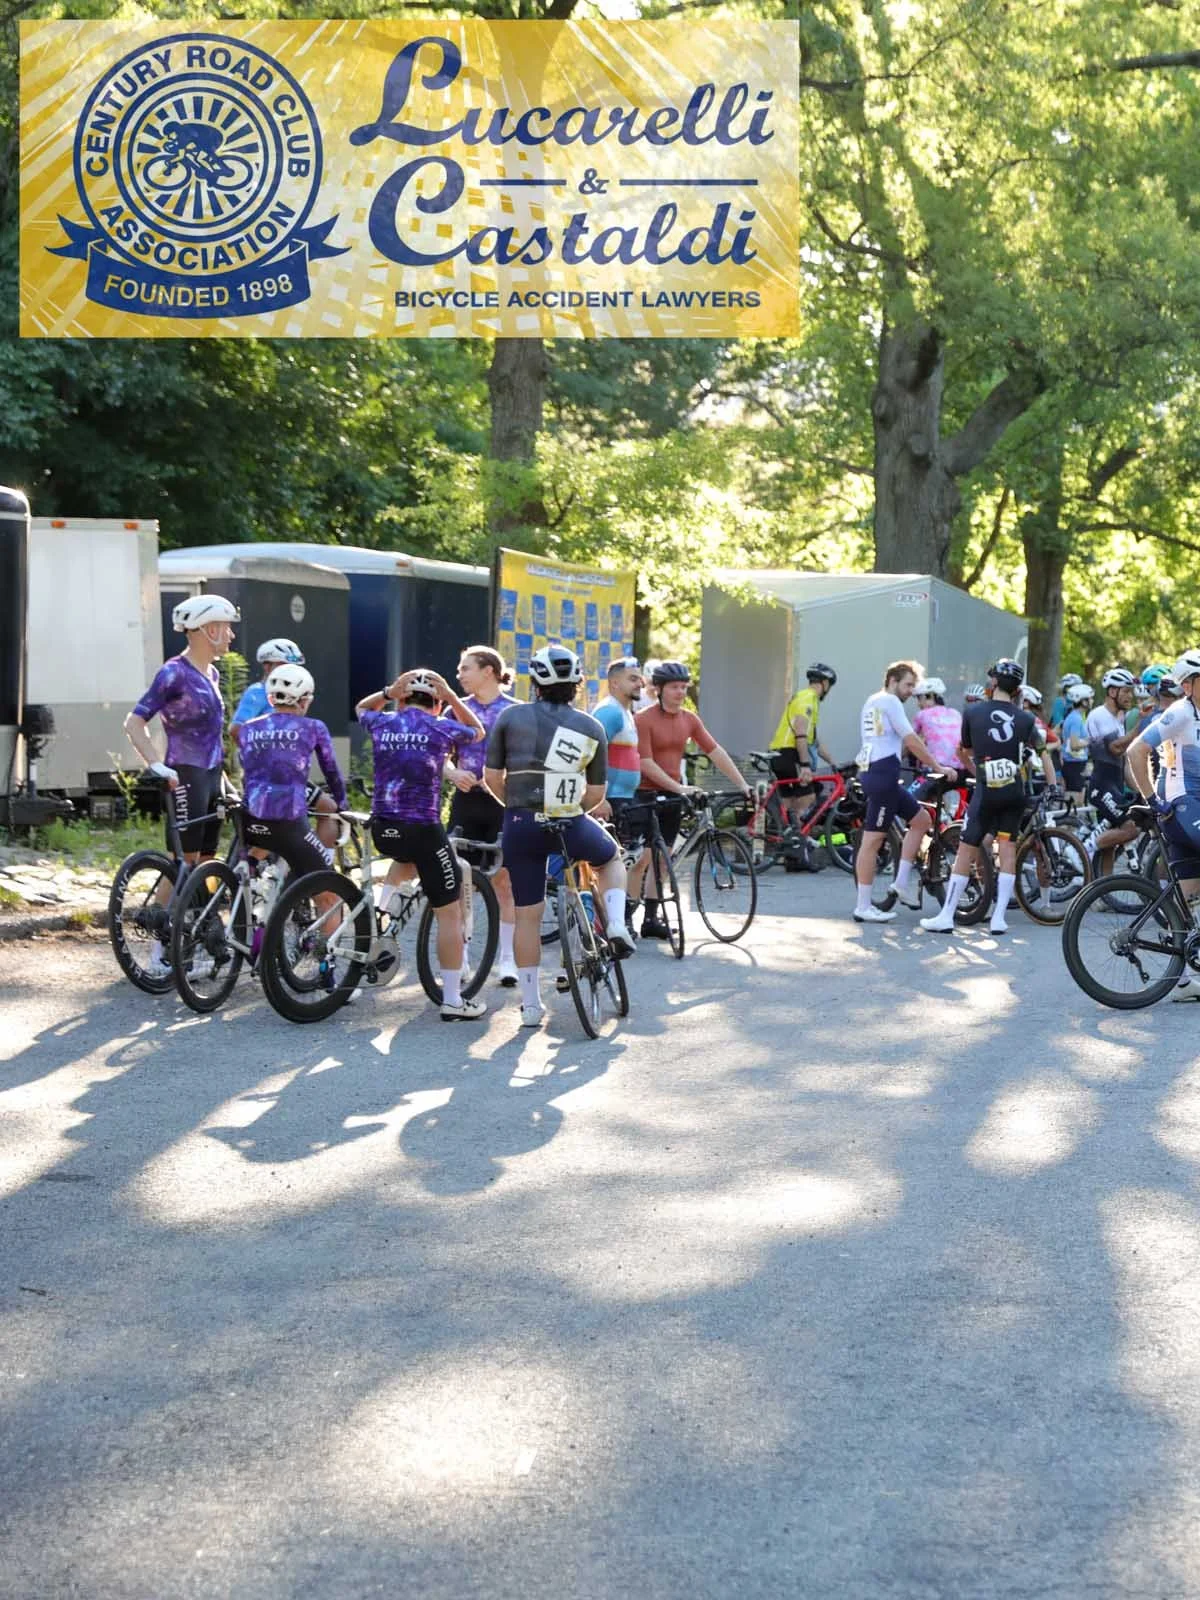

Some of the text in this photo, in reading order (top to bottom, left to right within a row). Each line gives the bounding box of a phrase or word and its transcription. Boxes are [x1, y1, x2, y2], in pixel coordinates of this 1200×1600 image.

[381, 729, 429, 744] inerro
[555, 738, 582, 764] 47
[991, 762, 1014, 779] 155
[555, 778, 577, 805] 47
[436, 845, 456, 890] inerro
